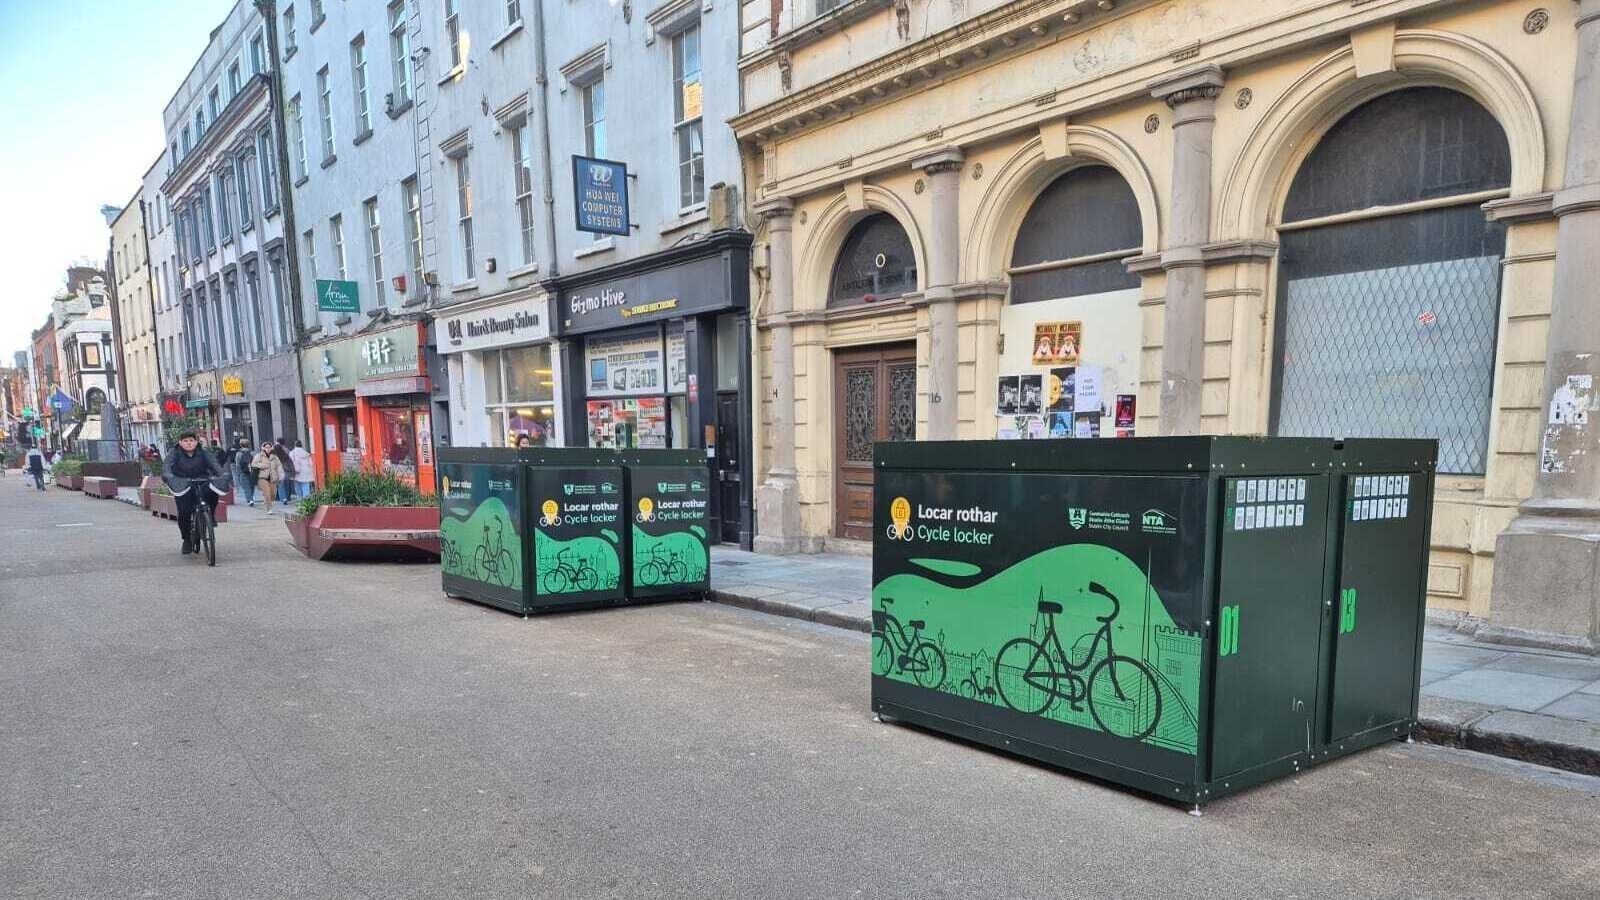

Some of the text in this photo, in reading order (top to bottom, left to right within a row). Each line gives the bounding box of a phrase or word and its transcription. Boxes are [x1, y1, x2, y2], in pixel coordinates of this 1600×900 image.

[582, 201, 624, 216] COMPUTER
[586, 214, 622, 228] SYSTEMS
[571, 295, 600, 315] Gizmo
[601, 288, 625, 307] Hive
[490, 317, 514, 334] Beauty
[515, 310, 539, 328] Salon
[564, 502, 619, 512] Locar rothar
[658, 499, 706, 509] Locar rothar
[564, 513, 617, 523] Cycle locker
[658, 510, 704, 520] Cycle locker
[918, 504, 998, 523] Locar rothar
[1142, 515, 1164, 526] NTA
[918, 525, 994, 544] Cycle locker
[1220, 605, 1240, 656] 01
